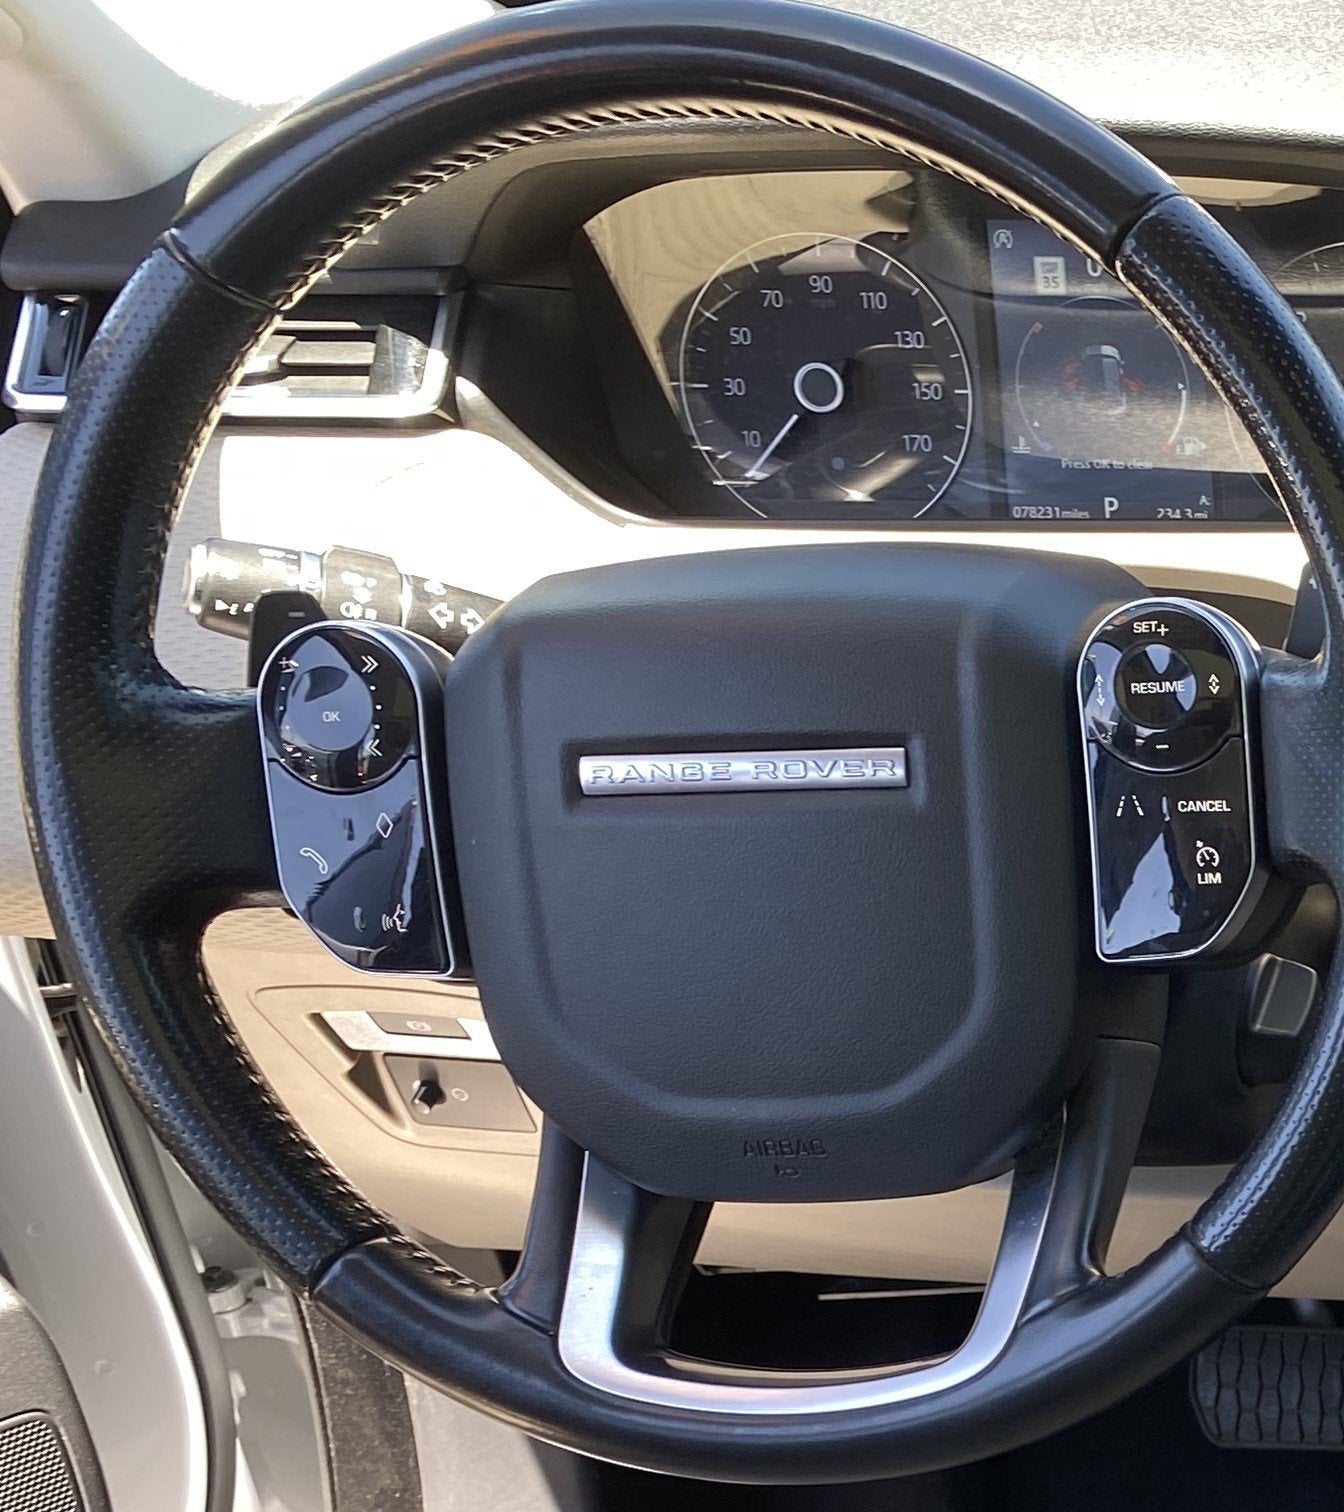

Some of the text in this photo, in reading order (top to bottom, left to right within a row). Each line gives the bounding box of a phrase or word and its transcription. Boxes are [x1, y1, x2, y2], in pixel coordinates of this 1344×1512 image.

[808, 275, 833, 293] 90
[1042, 275, 1060, 289] 35
[760, 289, 784, 308] 70
[859, 291, 888, 310] 110
[729, 327, 752, 345] 50
[893, 330, 925, 349] 130
[722, 378, 747, 396] 30
[912, 382, 943, 401] 150
[741, 430, 762, 448] 10
[901, 434, 933, 453] 170
[1061, 458, 1090, 469] Press
[1103, 497, 1120, 519] P
[1130, 679, 1186, 695] RESUME
[321, 710, 341, 723] OK
[589, 757, 897, 785] RANGE ROVER
[1177, 799, 1232, 813] CANCEL
[1197, 872, 1222, 885] LIM
[742, 1139, 828, 1158] AIRBAG
